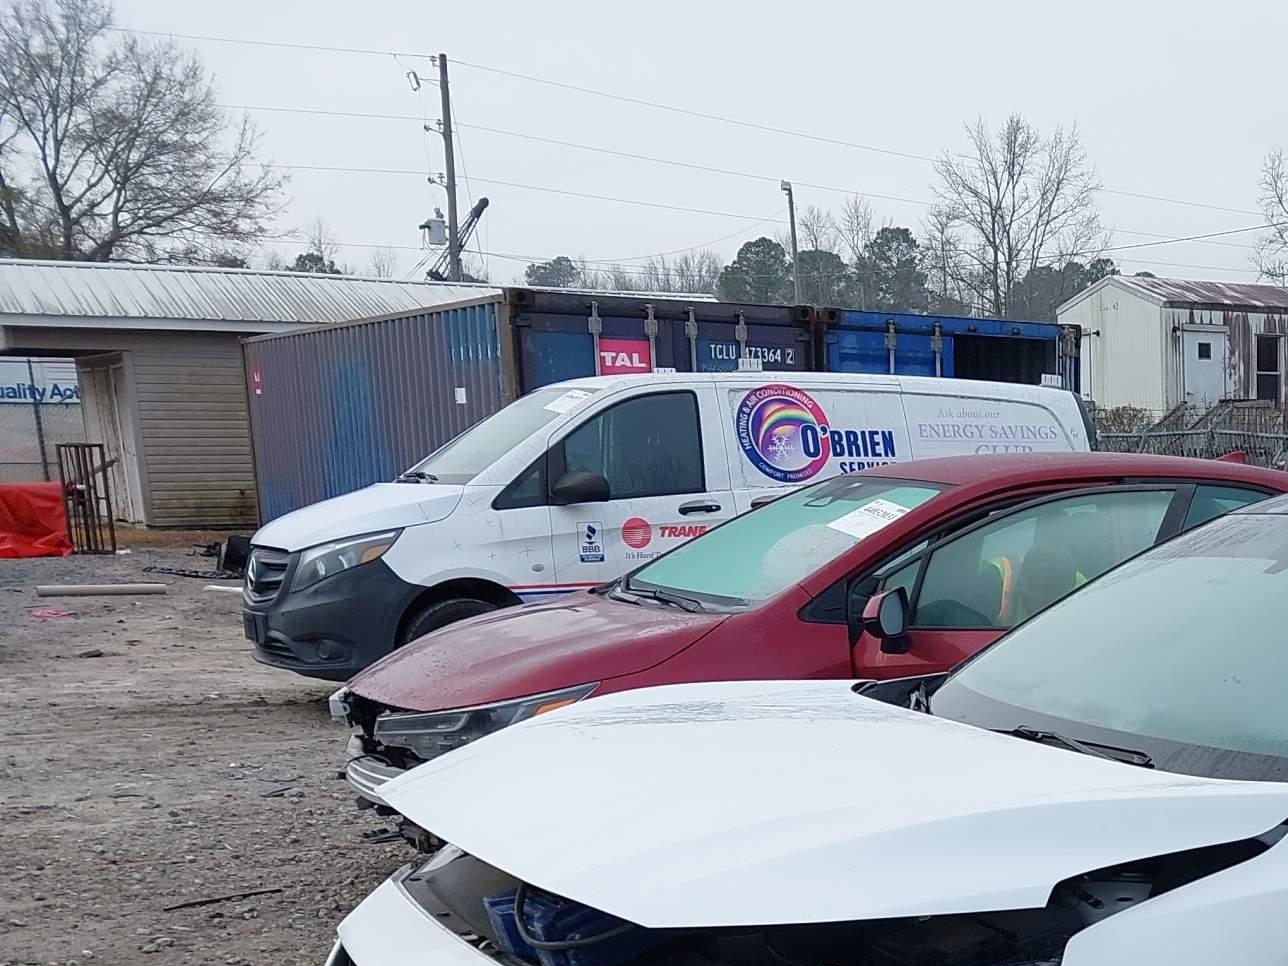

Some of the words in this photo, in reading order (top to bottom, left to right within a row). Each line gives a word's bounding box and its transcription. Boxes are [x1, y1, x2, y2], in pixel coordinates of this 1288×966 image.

[600, 351, 647, 368] TAL
[710, 344, 736, 360] TCLU
[786, 348, 794, 364] 2
[740, 413, 752, 450] HEATING
[746, 394, 759, 409] AIR
[757, 387, 814, 409] CONDITIONING
[937, 408, 954, 418] Ask
[956, 408, 983, 418] about
[918, 423, 984, 439] ENERGY
[990, 424, 1057, 440] SAVINGS
[759, 462, 785, 479] COMFORT
[787, 468, 813, 480] PROMISED
[582, 545, 601, 553] BBB
